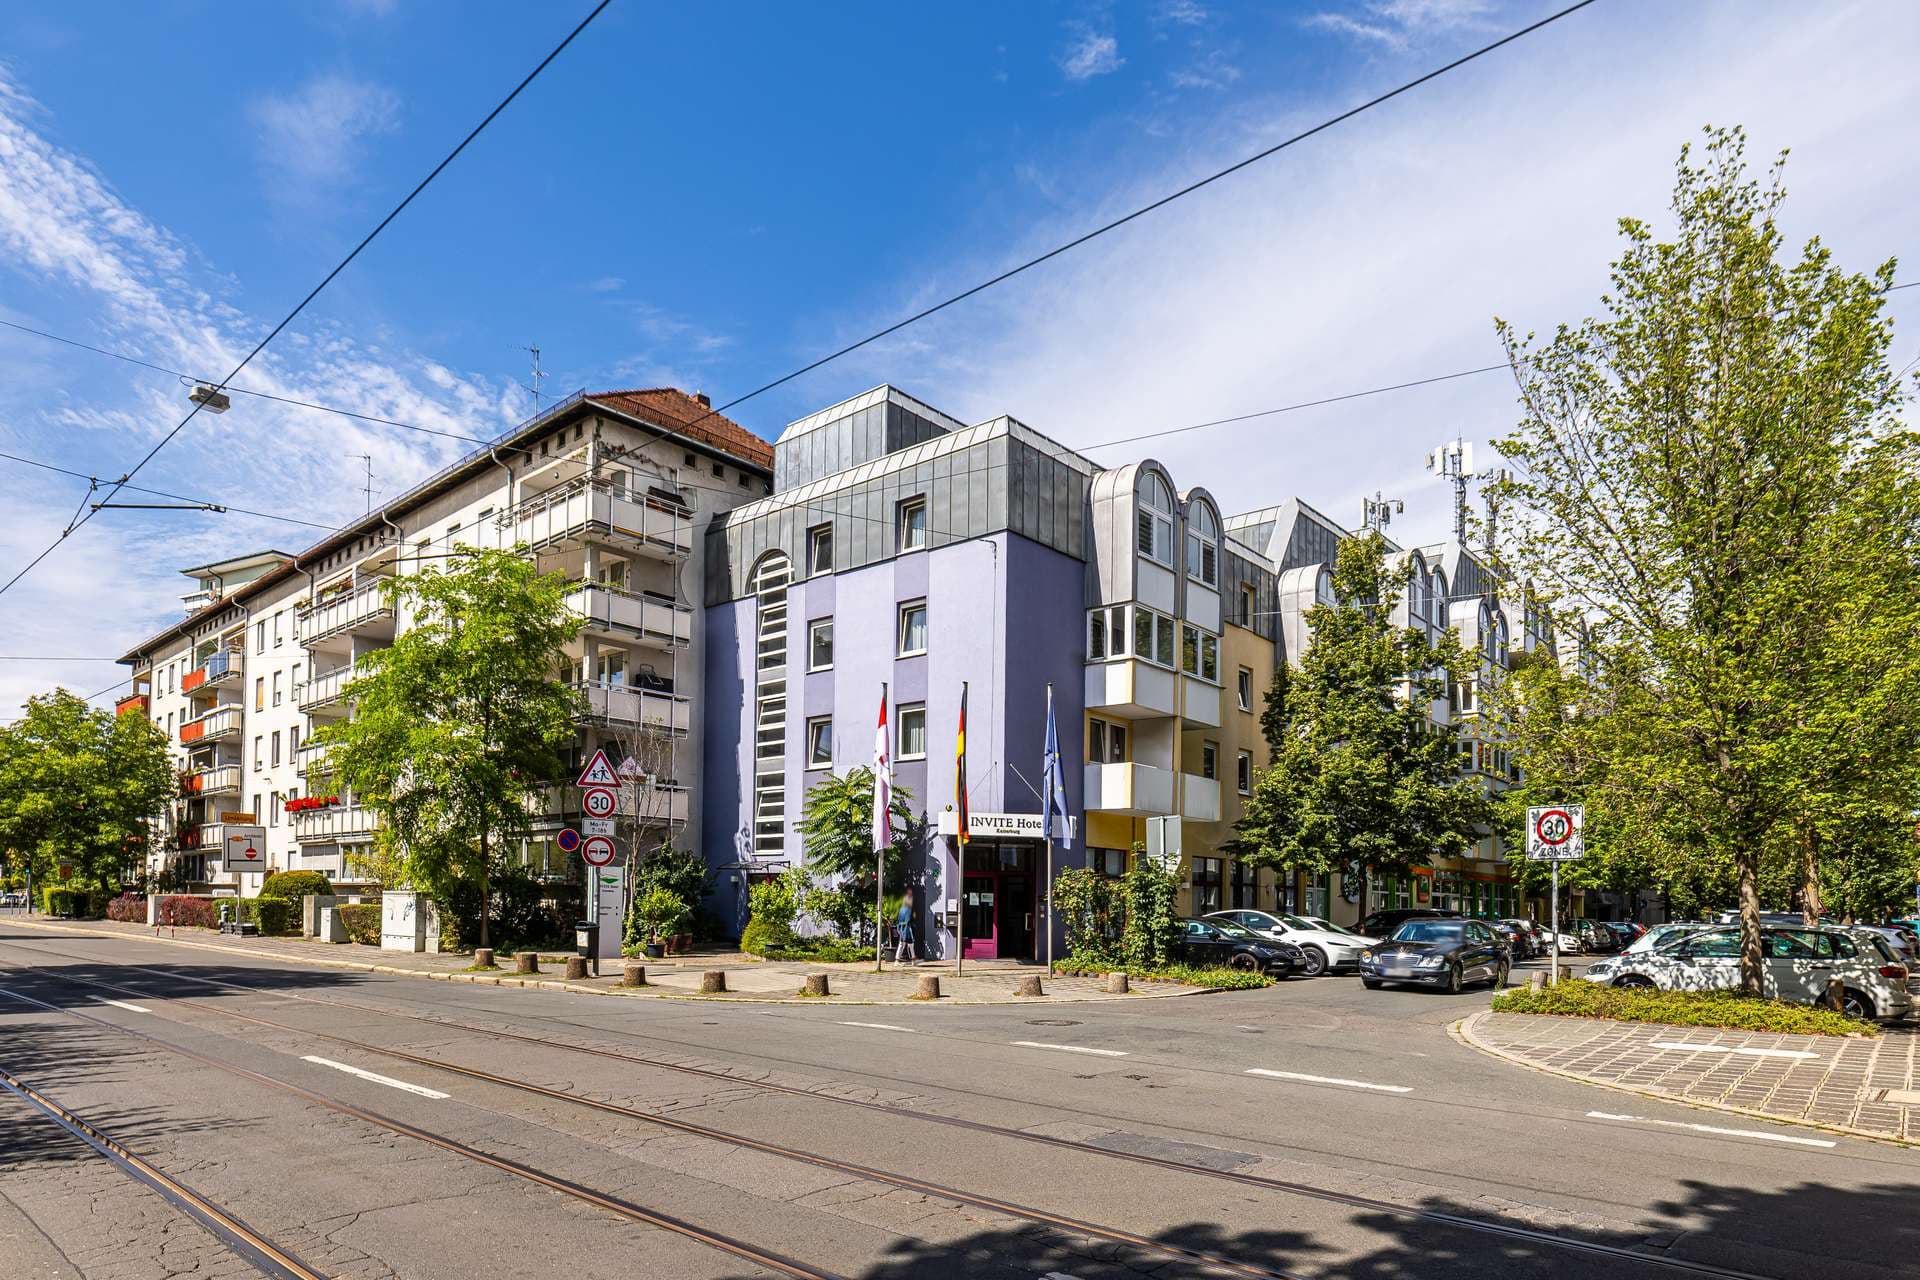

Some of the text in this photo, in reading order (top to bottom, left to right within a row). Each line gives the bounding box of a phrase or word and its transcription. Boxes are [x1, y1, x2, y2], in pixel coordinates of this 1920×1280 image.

[591, 796, 609, 810] 30
[971, 816, 1013, 828] INVITE
[1544, 820, 1565, 835] 30
[1539, 847, 1570, 857] ZONE
